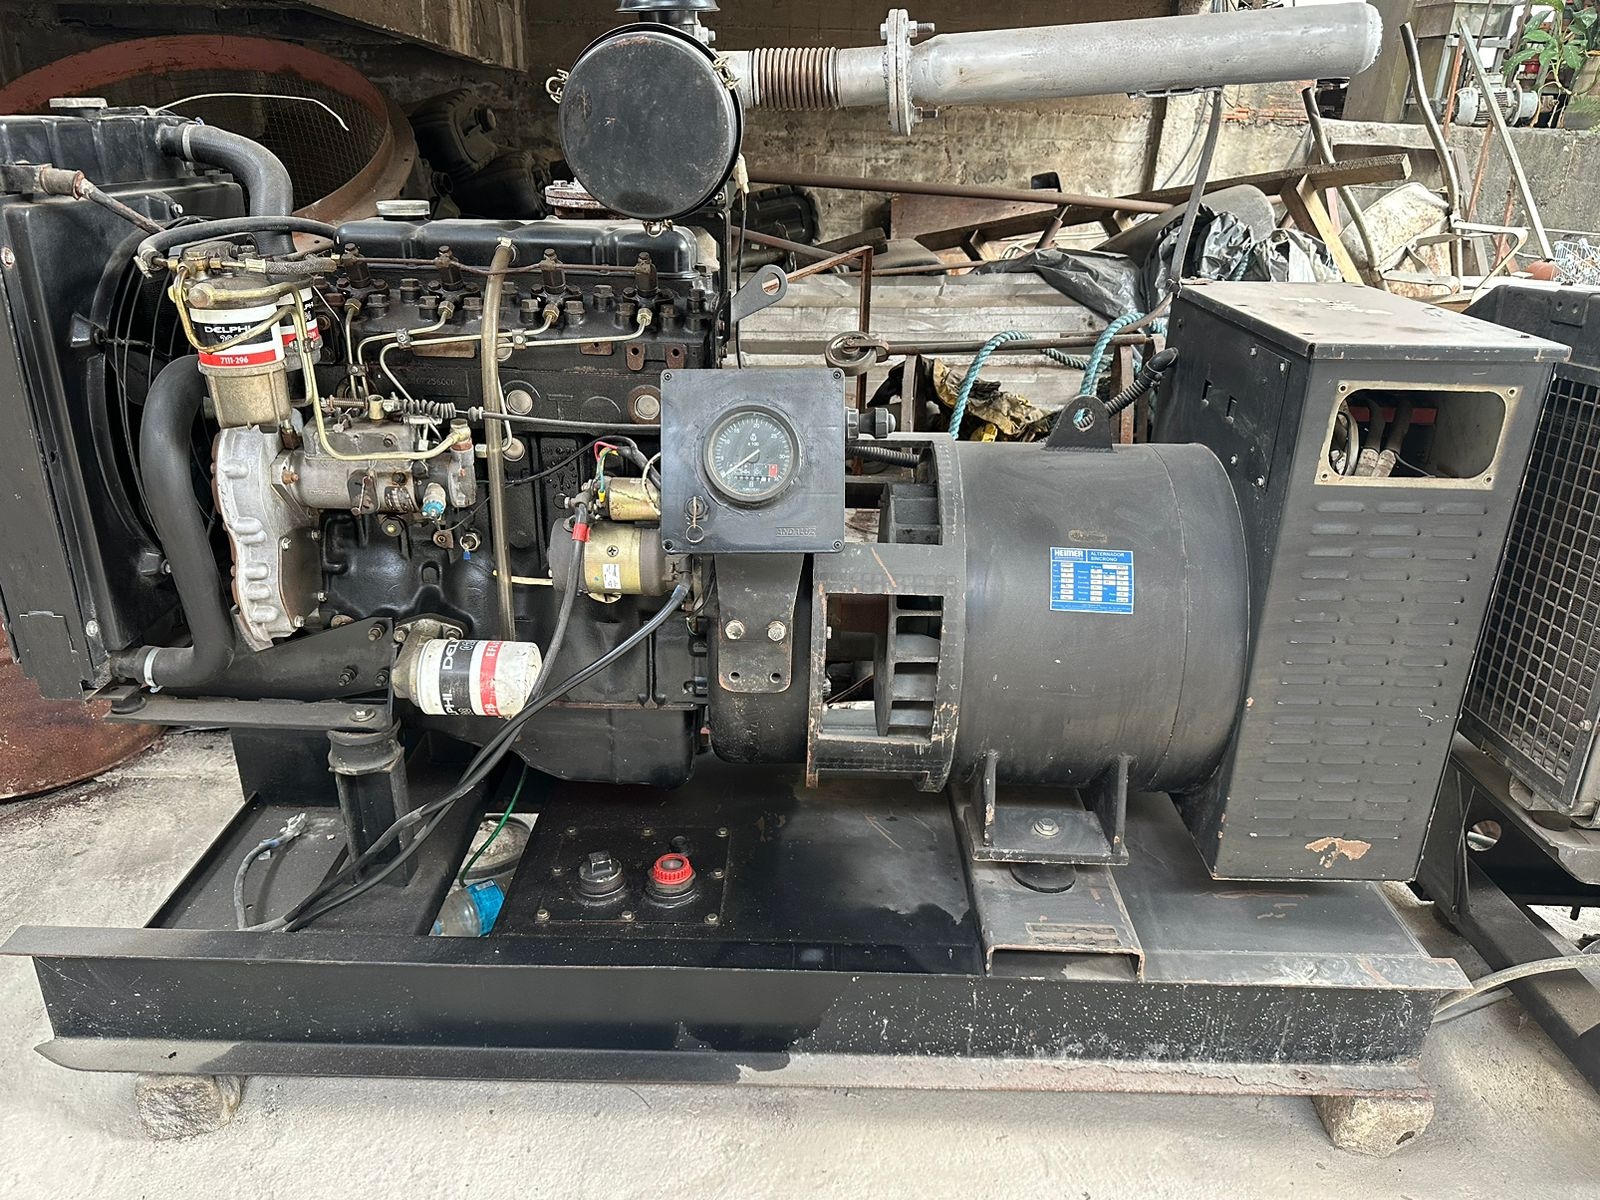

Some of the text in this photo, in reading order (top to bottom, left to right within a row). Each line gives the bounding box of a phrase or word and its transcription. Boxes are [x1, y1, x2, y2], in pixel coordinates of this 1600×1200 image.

[204, 325, 251, 333] DELPHI
[220, 356, 249, 364] 7111-296
[775, 527, 816, 537] ANDALUZ
[1054, 549, 1083, 558] HEIMER
